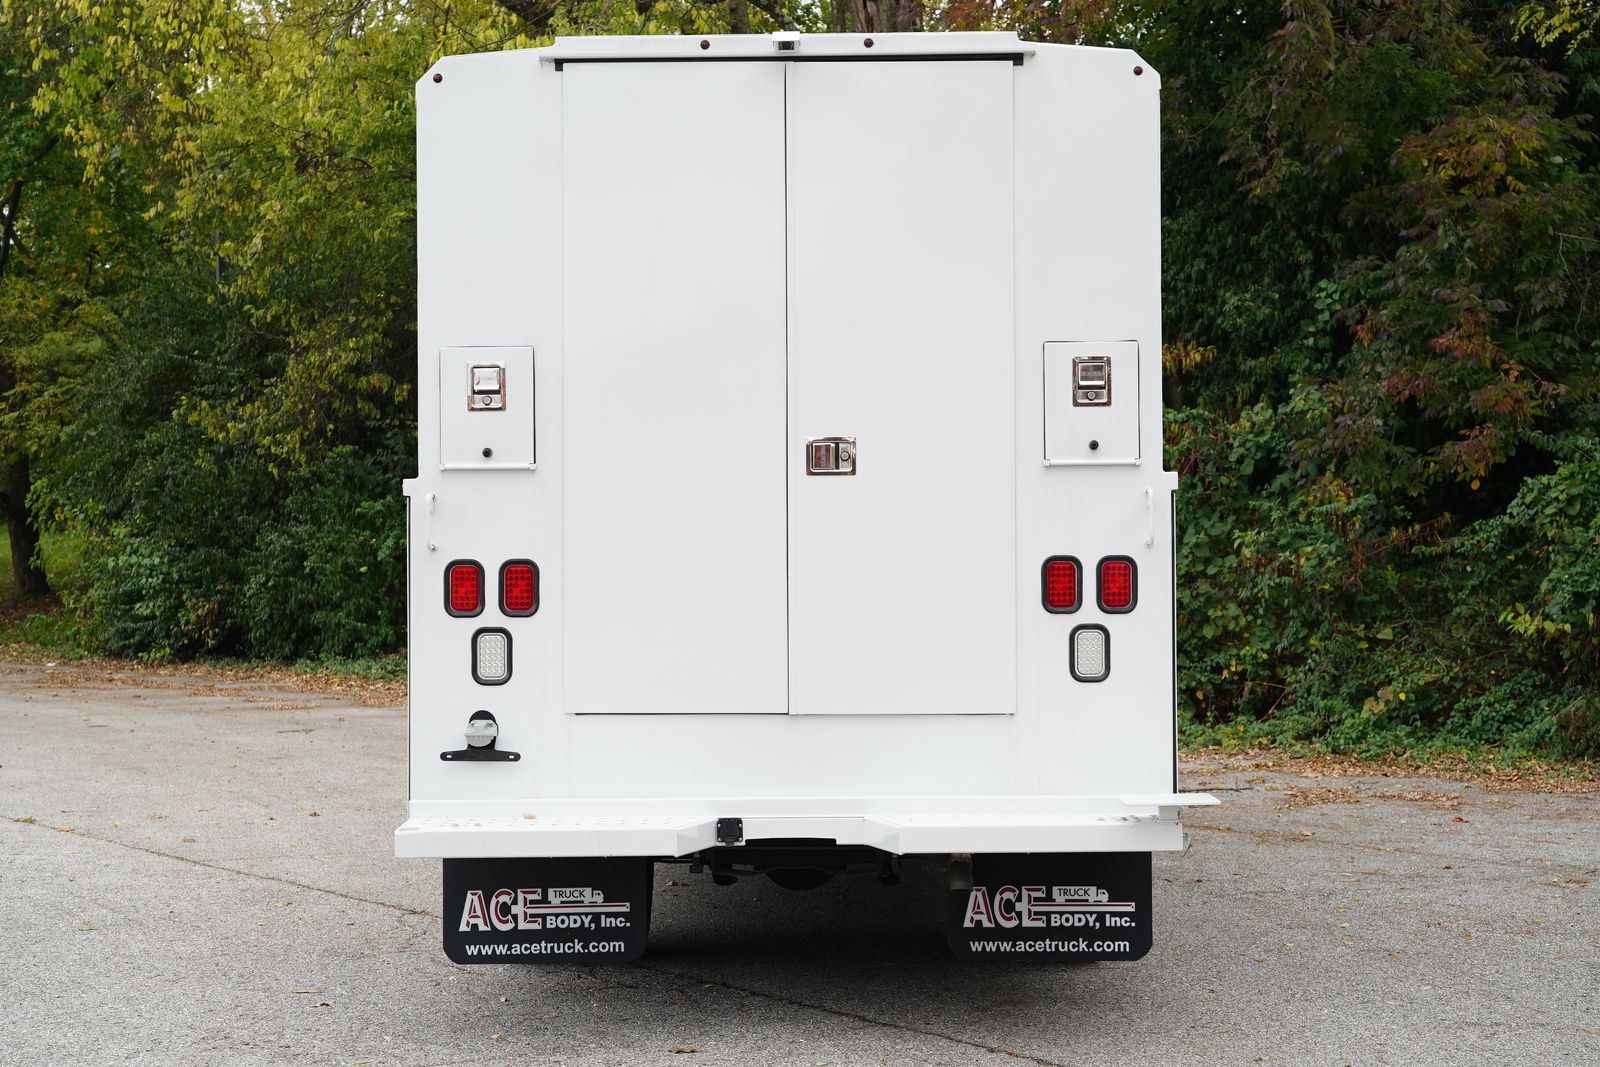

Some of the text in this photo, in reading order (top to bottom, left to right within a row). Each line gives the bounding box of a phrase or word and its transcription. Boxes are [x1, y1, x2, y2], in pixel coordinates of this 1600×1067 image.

[553, 889, 586, 899] TRUCK
[1057, 888, 1091, 897] TRUCK
[458, 888, 542, 932] ACE
[963, 885, 1046, 929] ACE
[546, 914, 631, 931] BODY, Inc.
[1050, 913, 1136, 930] BODY, Inc.
[465, 939, 625, 956] www.acetruck.com
[969, 938, 1130, 952] www.acetruck.com
